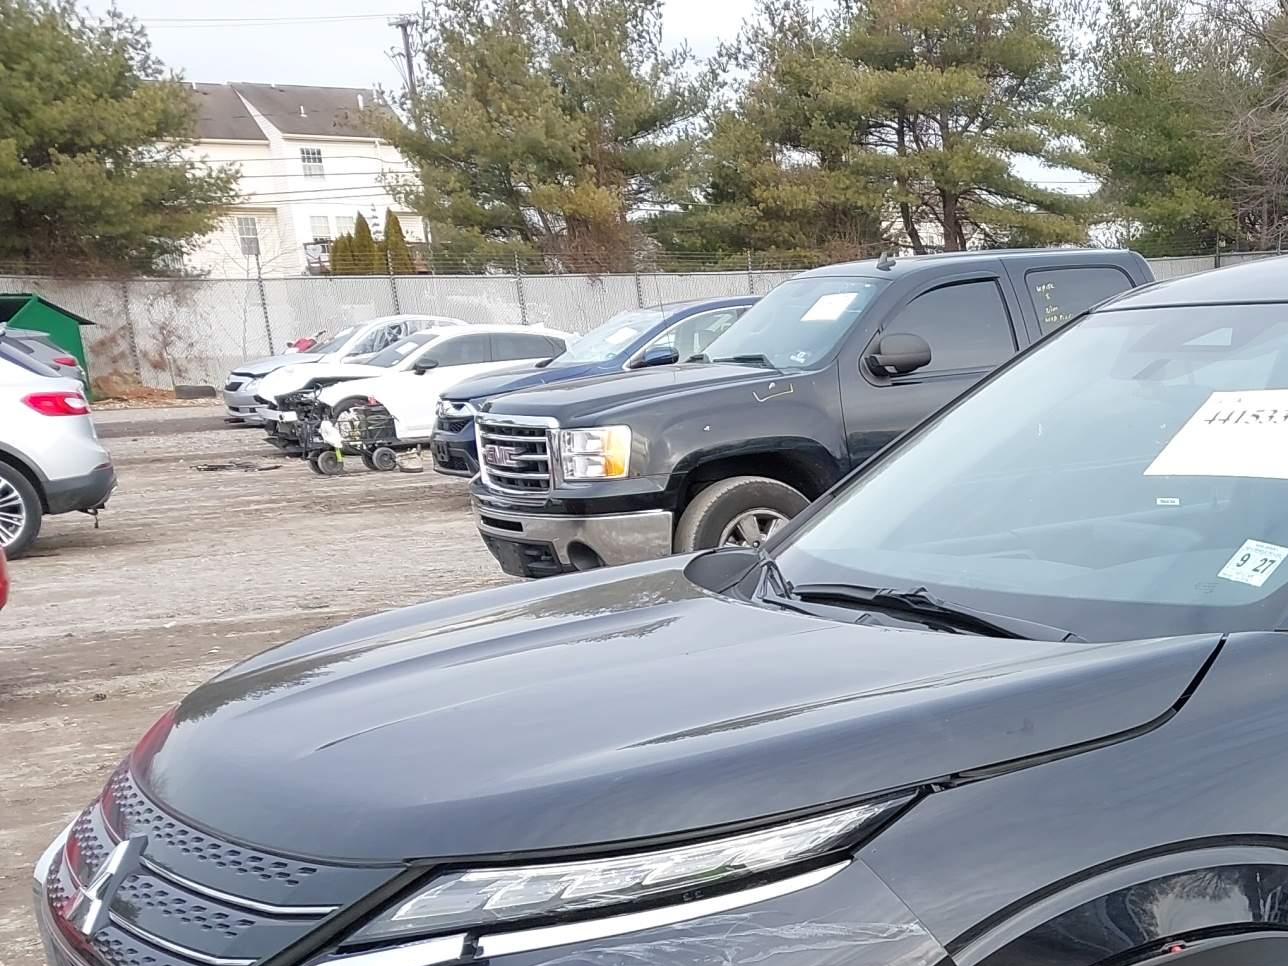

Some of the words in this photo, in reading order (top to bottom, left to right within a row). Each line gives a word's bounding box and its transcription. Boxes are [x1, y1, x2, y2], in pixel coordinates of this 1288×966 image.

[485, 444, 527, 467] GMC
[1236, 553, 1251, 568] 9
[1252, 557, 1276, 574] 27
